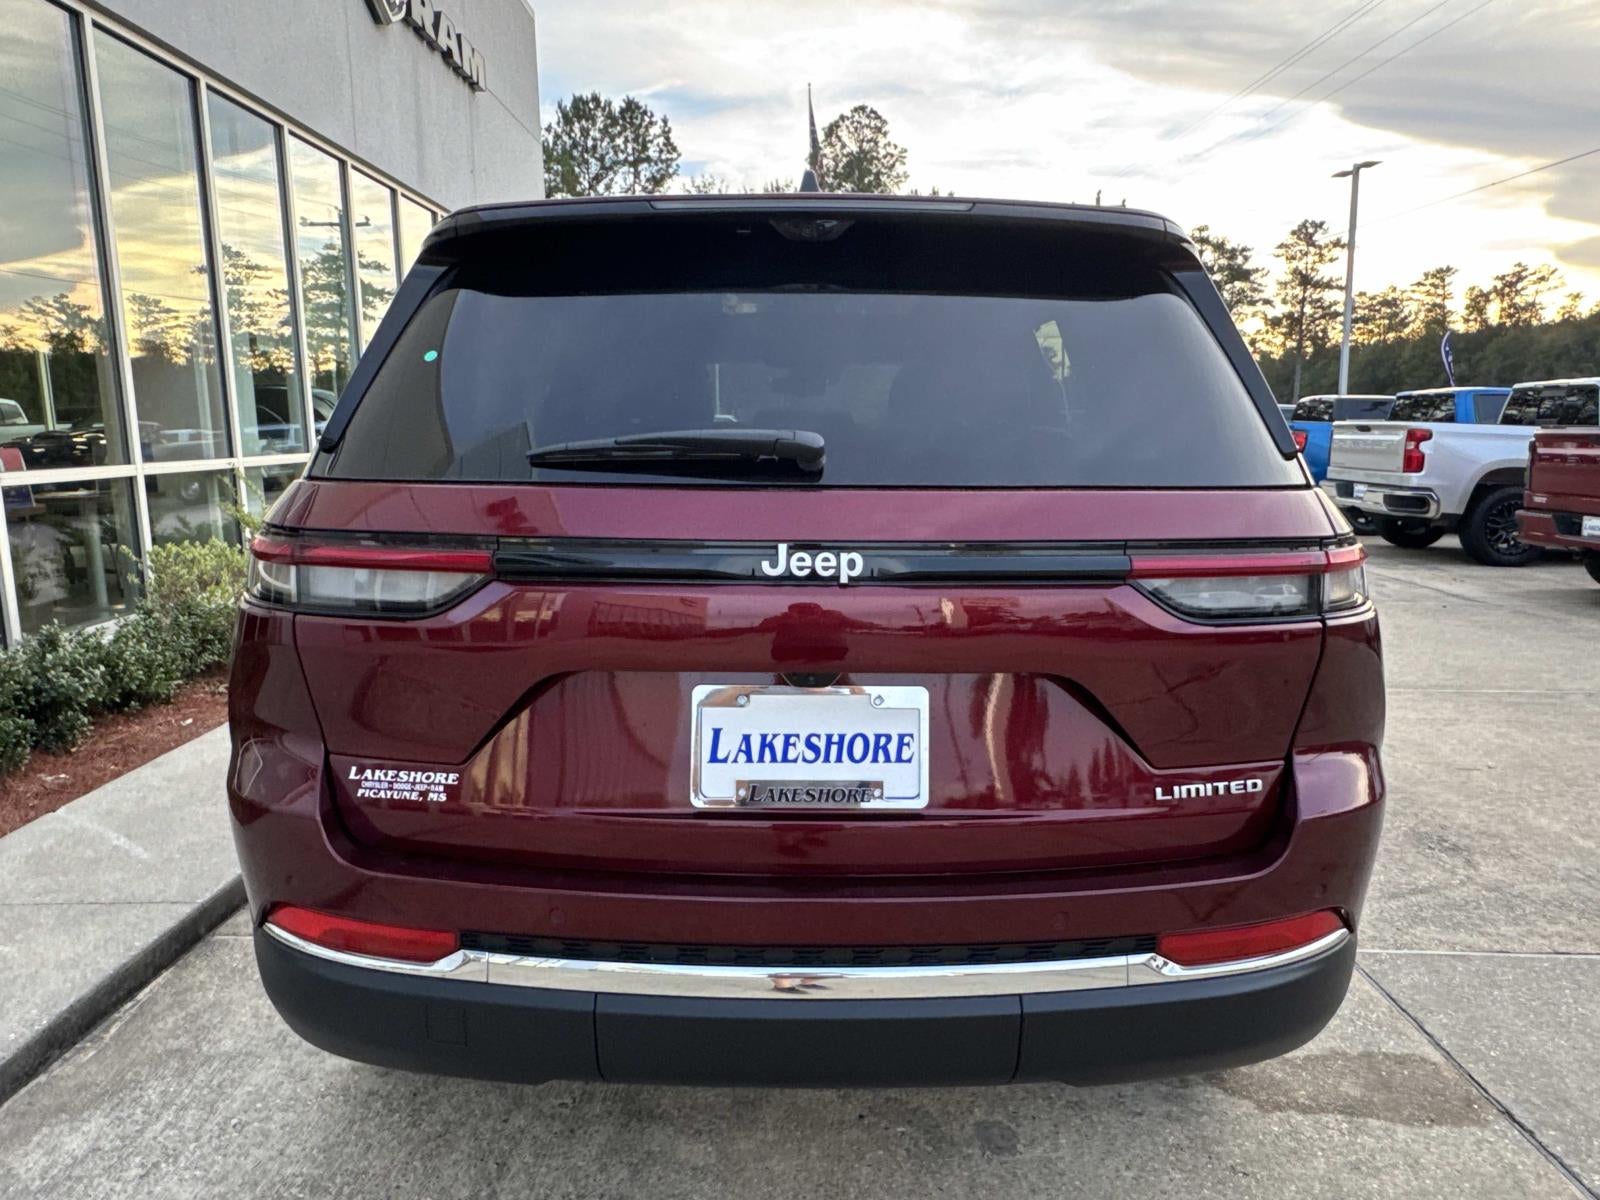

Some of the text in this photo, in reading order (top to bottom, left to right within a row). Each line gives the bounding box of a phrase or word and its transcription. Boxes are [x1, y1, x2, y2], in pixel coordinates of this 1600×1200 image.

[410, 0, 486, 91] RAM
[761, 543, 864, 584] Jeep
[707, 728, 915, 764] LAKESHORE
[348, 766, 460, 784] LAKESHORE
[356, 788, 447, 802] PICAYUNE, MS
[749, 784, 873, 804] LAKESHORE
[1155, 779, 1263, 800] LIMITED
